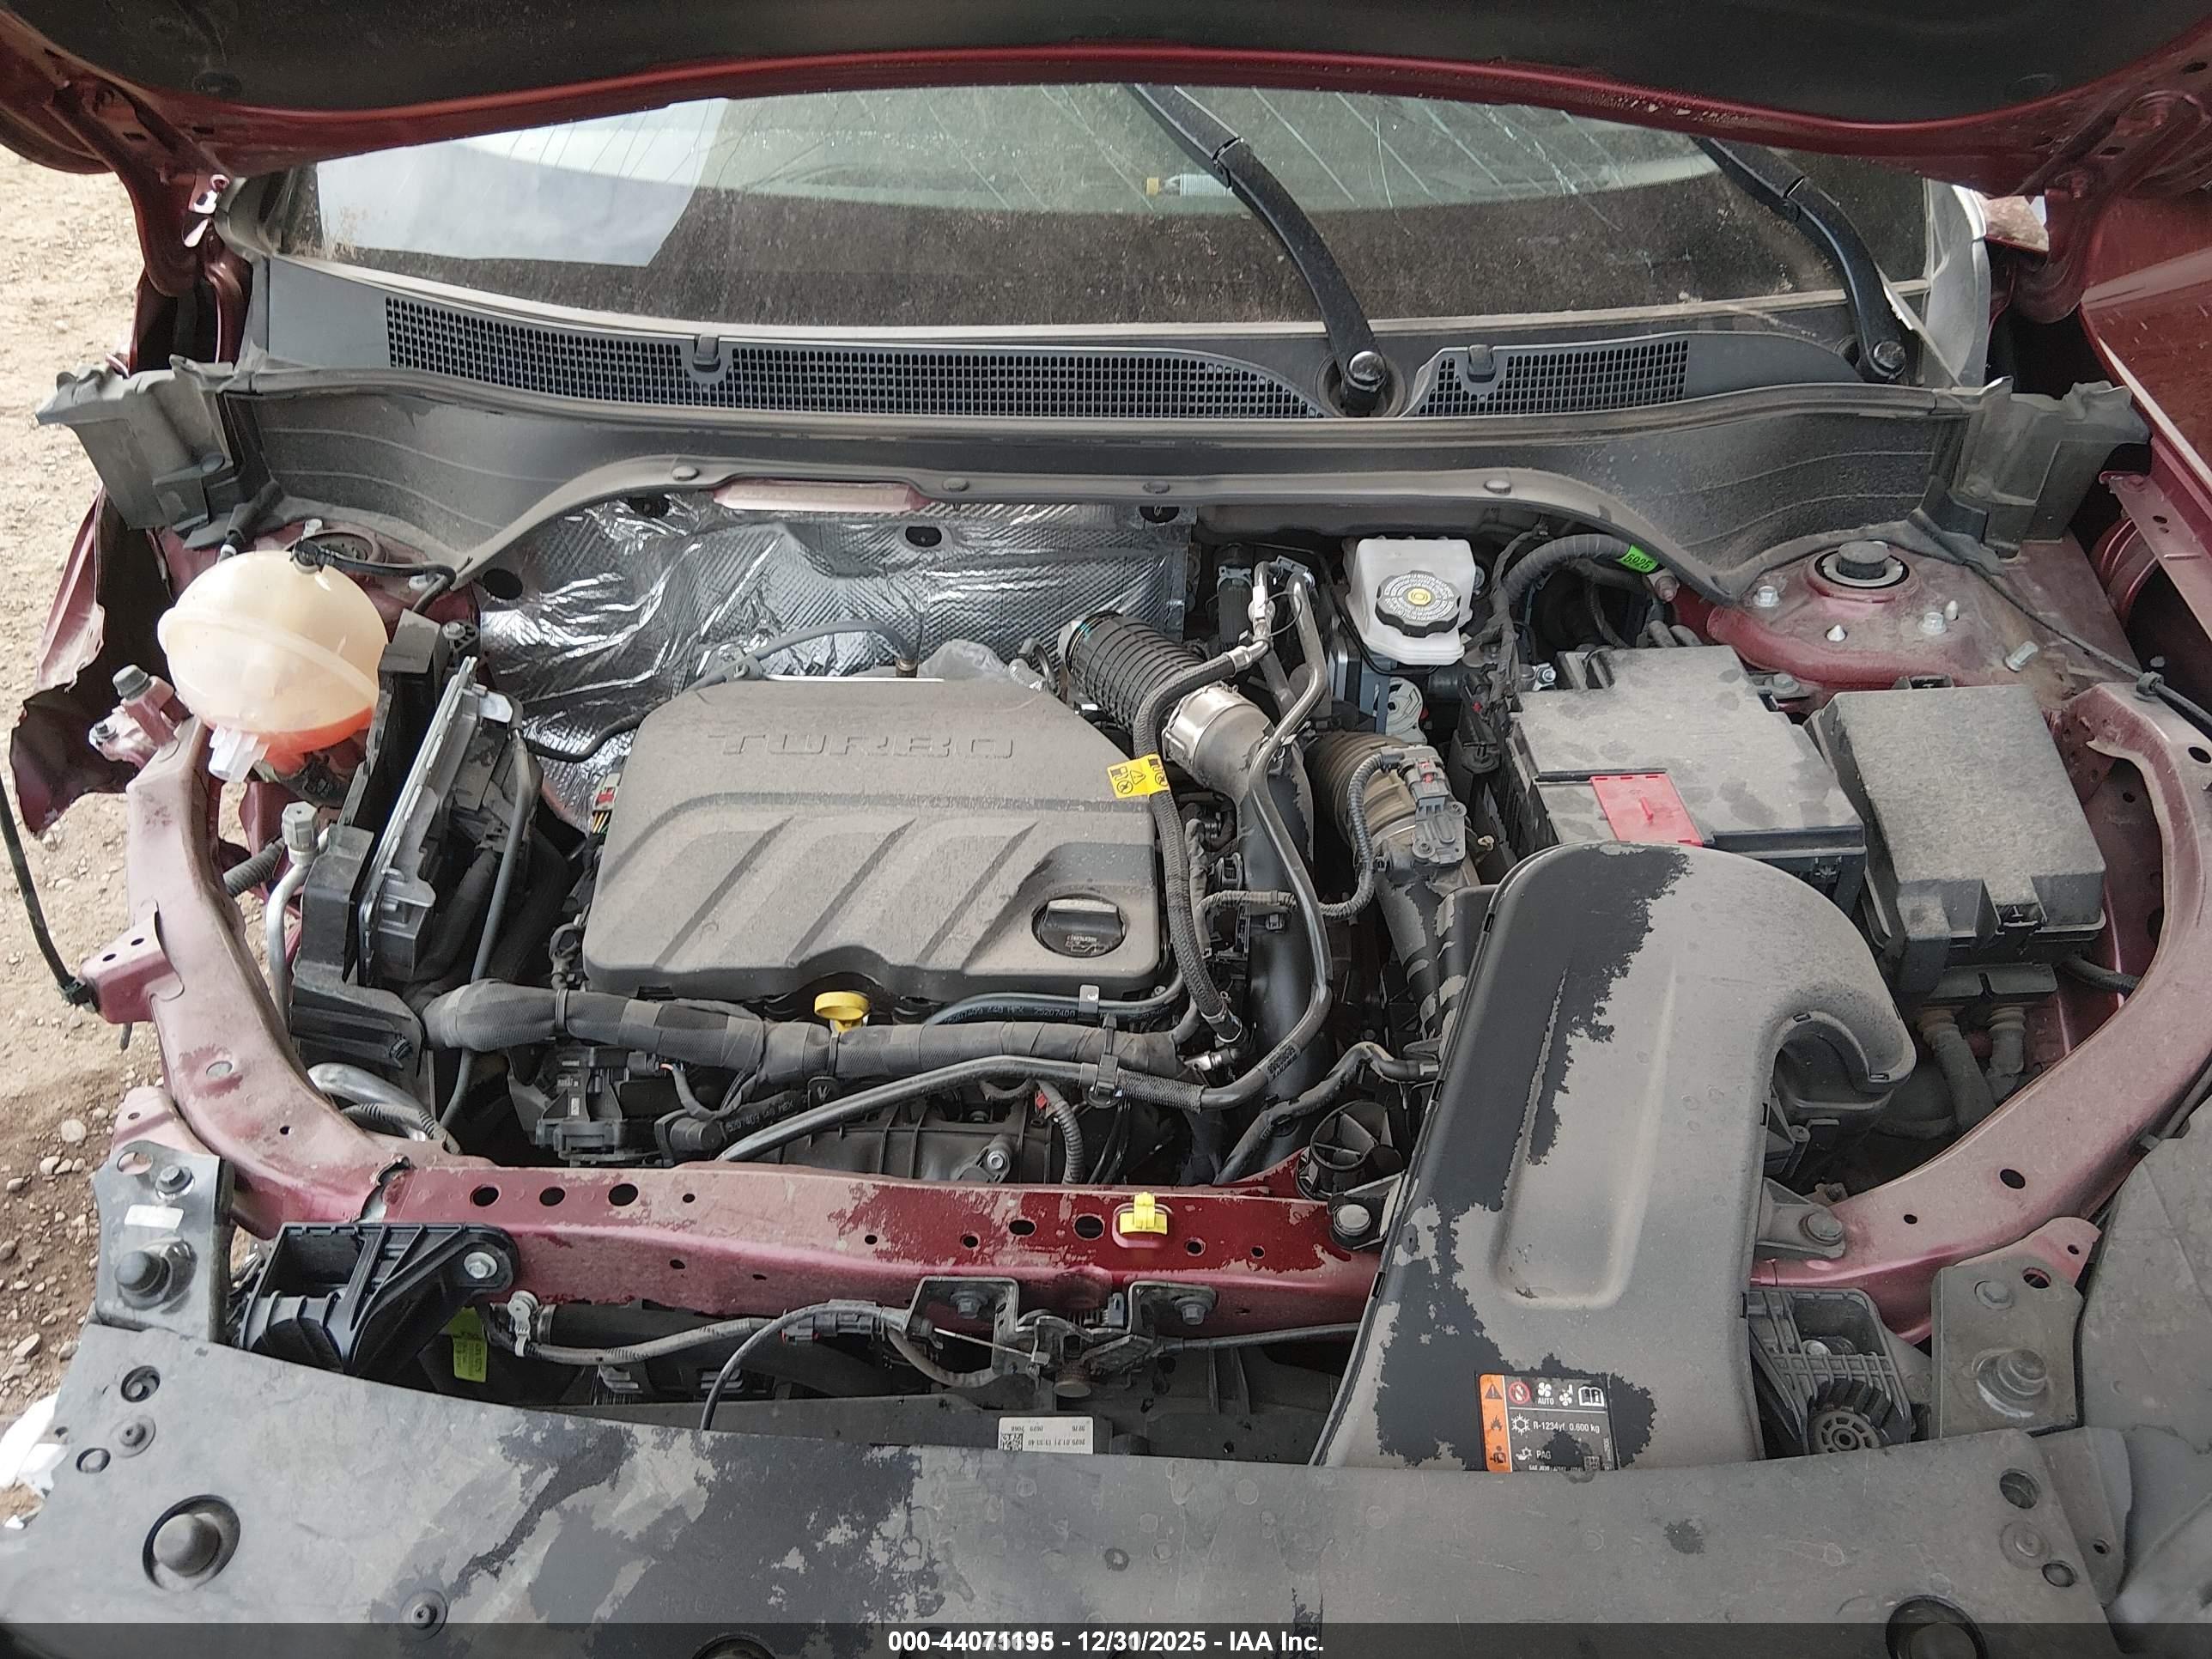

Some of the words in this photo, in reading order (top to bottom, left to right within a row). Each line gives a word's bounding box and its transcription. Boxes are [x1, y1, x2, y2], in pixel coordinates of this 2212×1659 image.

[707, 733, 1014, 759] TURBO
[1533, 1421, 1565, 1431] R-1234yf
[1590, 1424, 1600, 1434] kg
[1536, 1450, 1552, 1460] PAG
